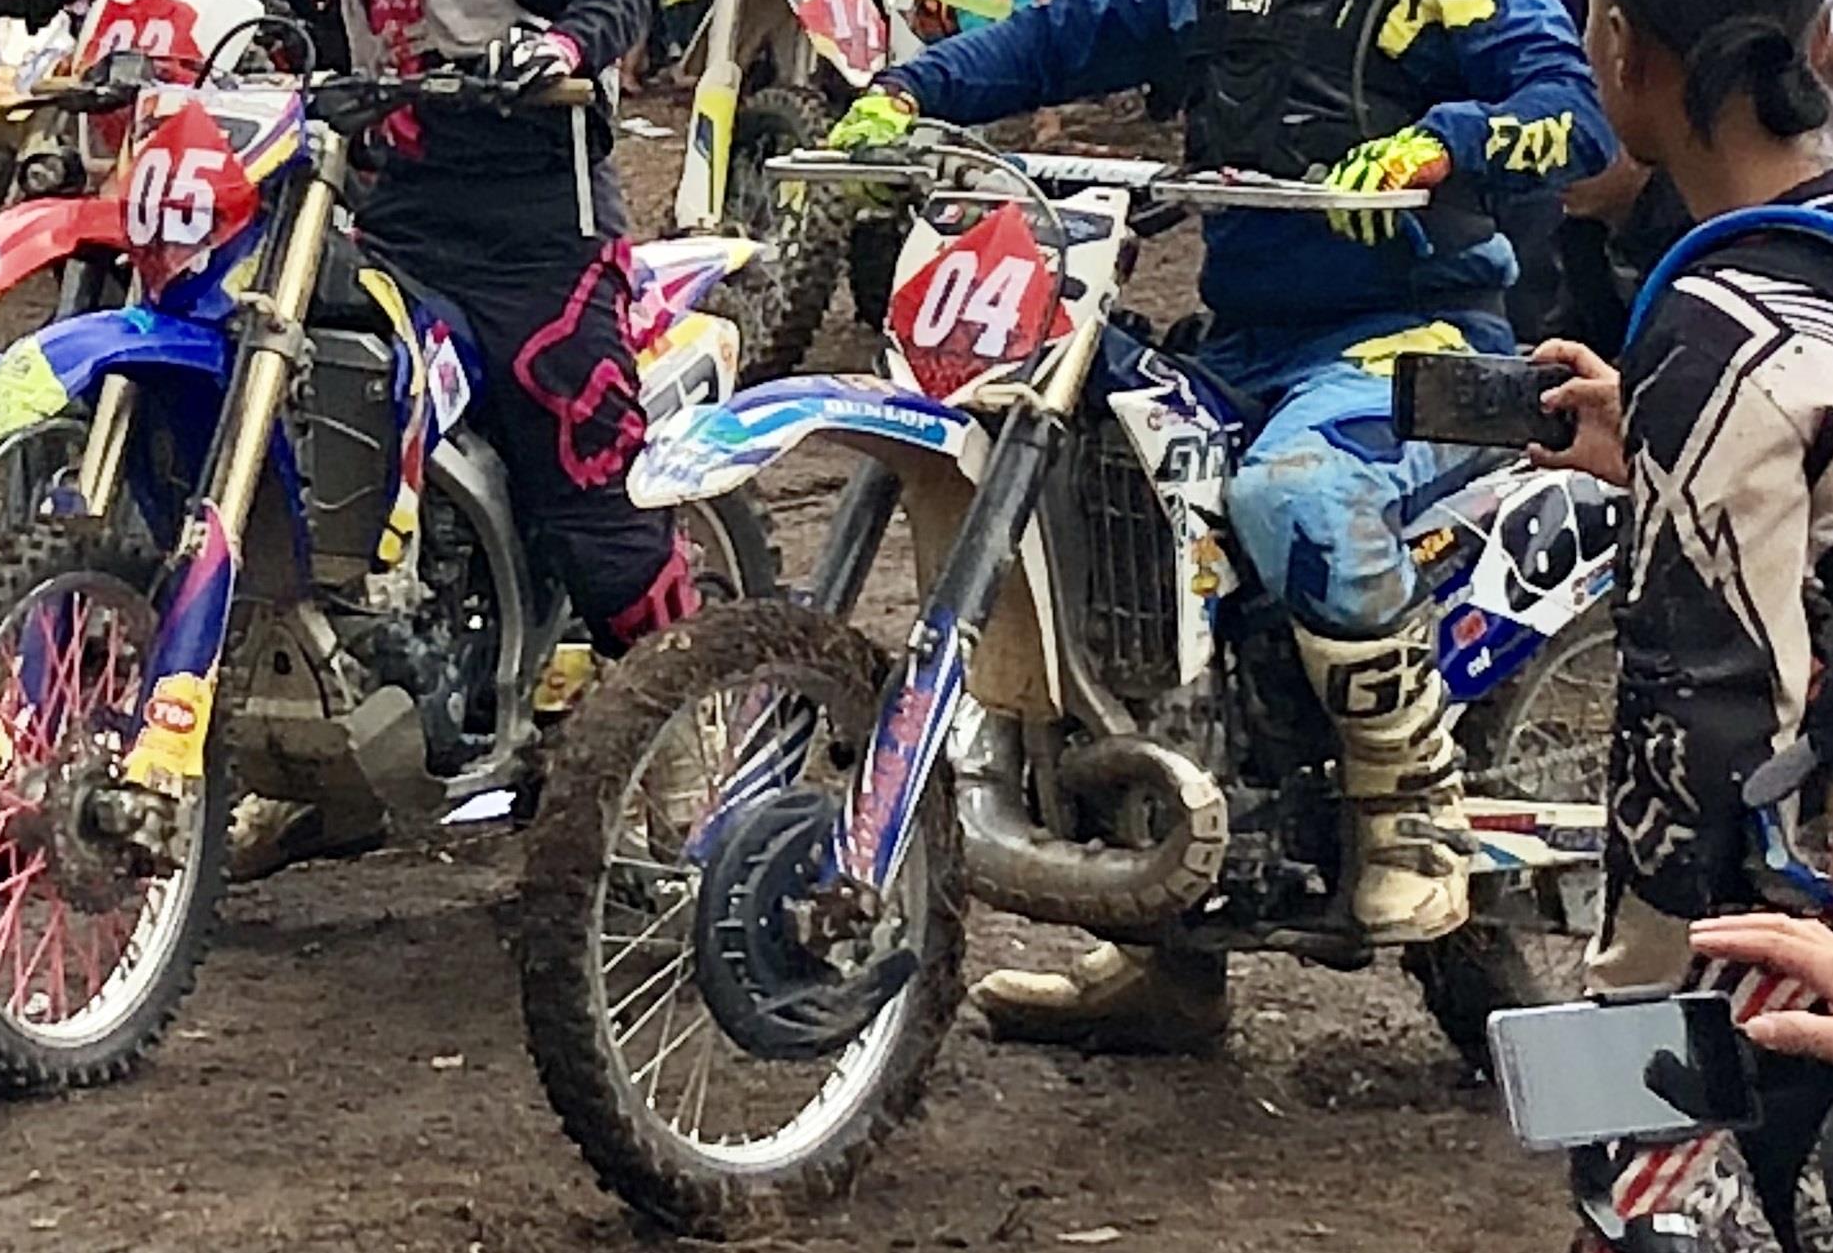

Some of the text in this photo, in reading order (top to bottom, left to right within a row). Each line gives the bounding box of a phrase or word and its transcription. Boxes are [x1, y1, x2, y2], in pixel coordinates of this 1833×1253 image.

[1486, 111, 1573, 176] FOX
[126, 149, 226, 246] 05
[913, 250, 1036, 358] 04
[822, 399, 936, 430] DUNLOP
